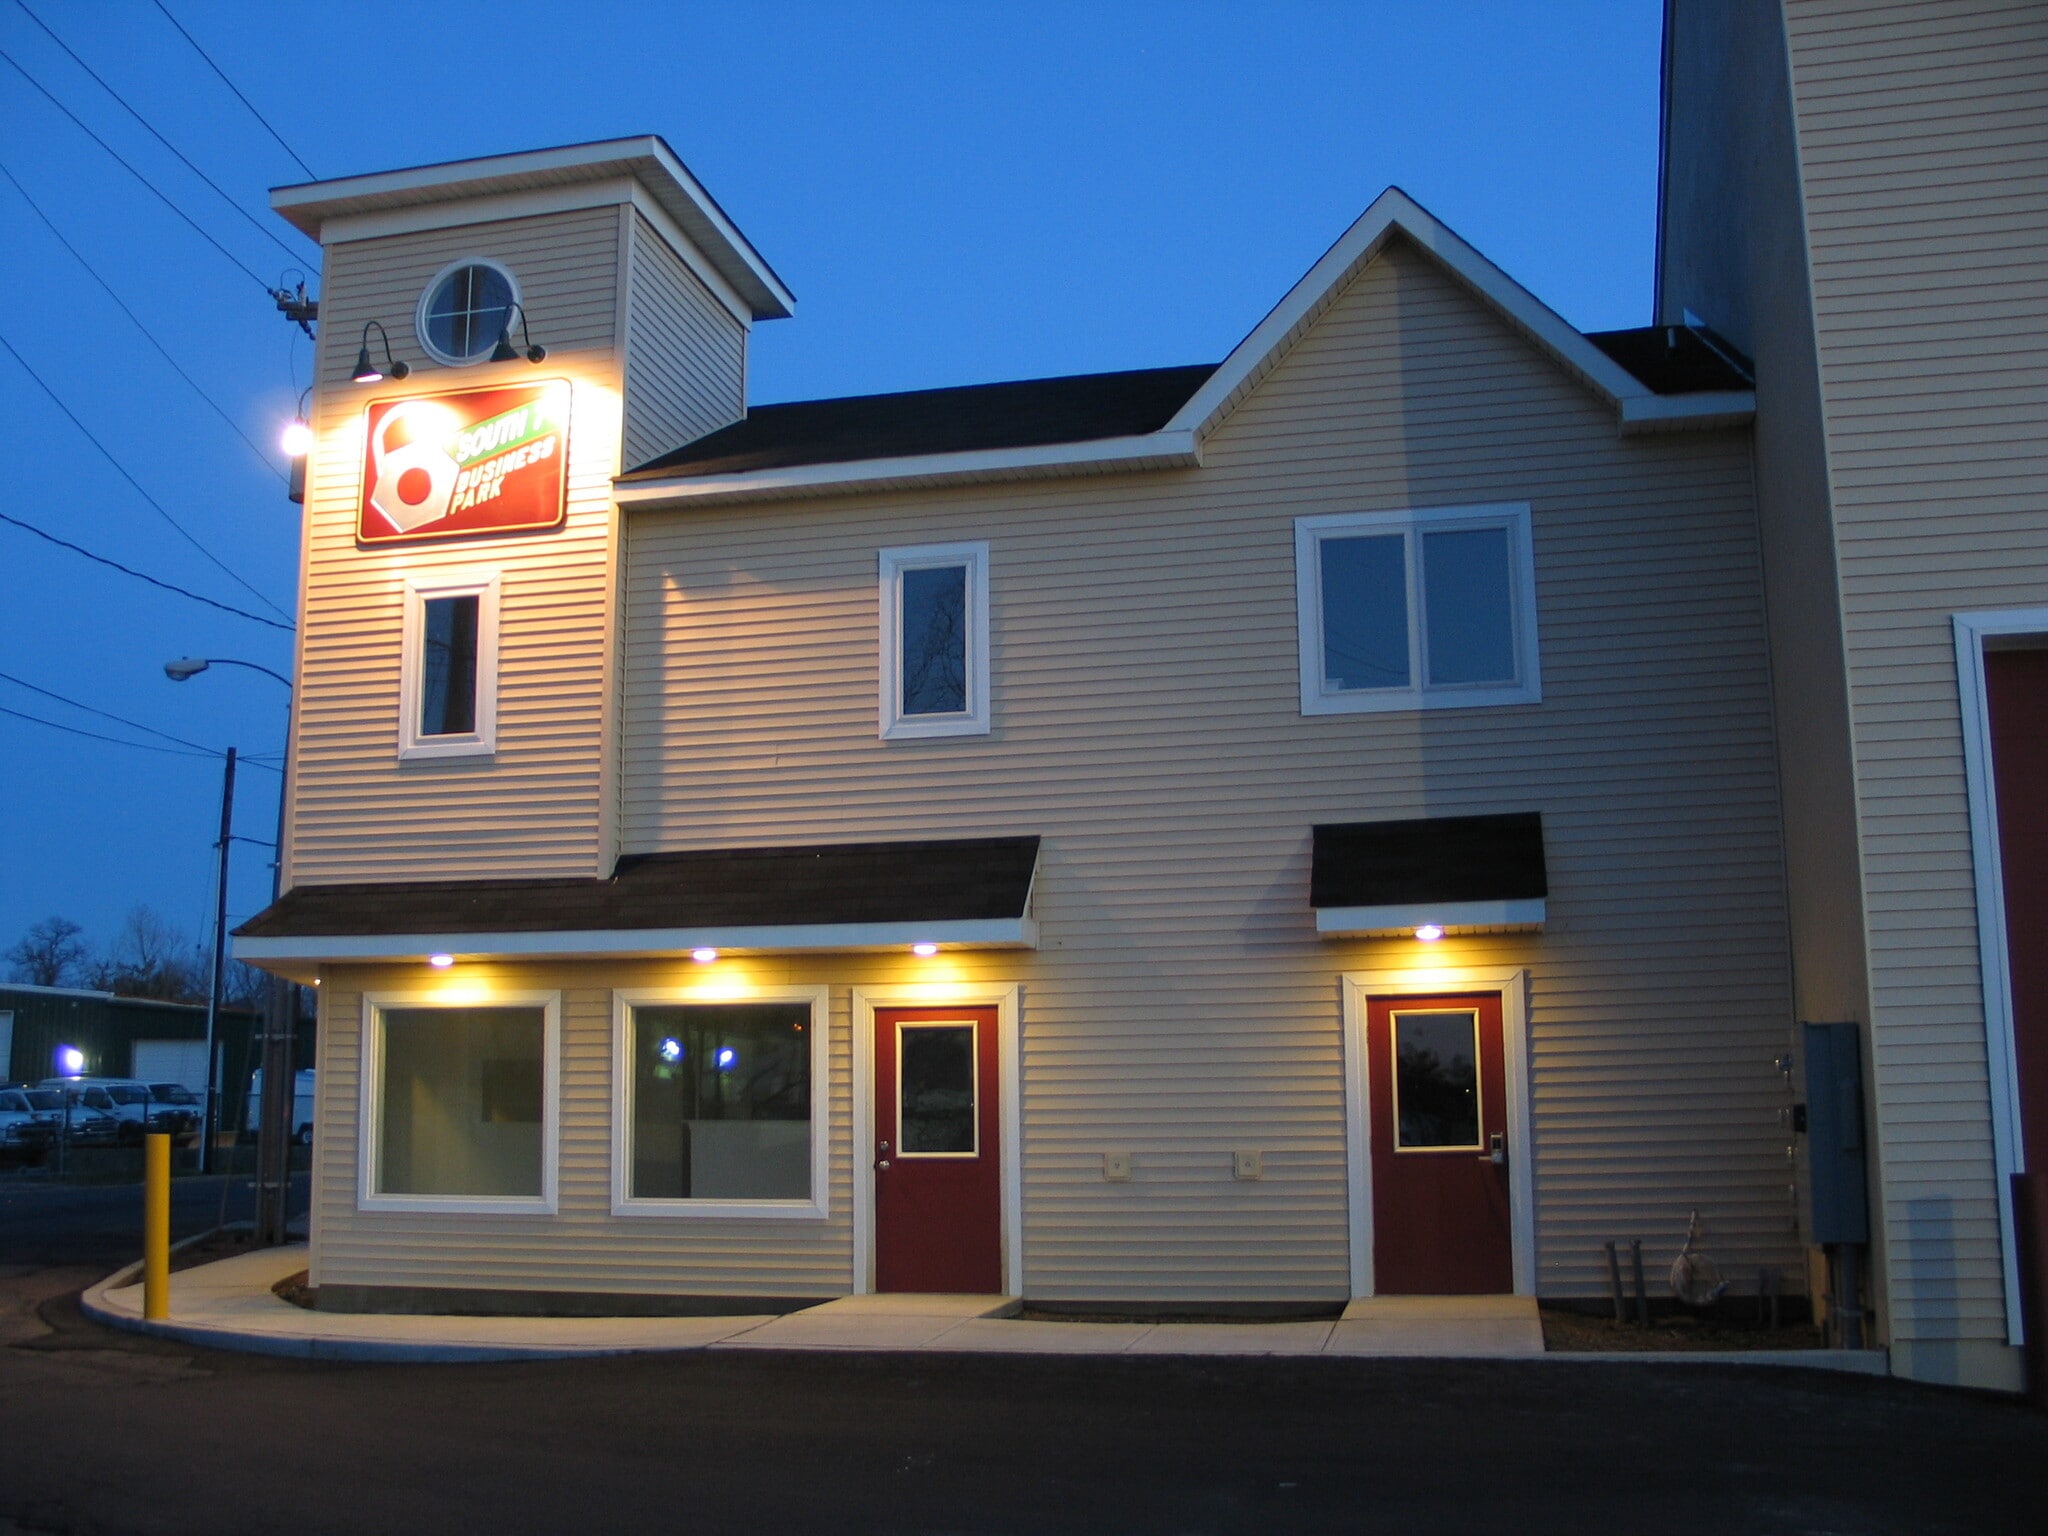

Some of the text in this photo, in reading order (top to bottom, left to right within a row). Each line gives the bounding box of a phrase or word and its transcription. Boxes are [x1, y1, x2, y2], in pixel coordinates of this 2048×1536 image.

[456, 408, 529, 463] SOUTH
[456, 436, 556, 493] BUSINESS
[450, 475, 505, 515] PARK
